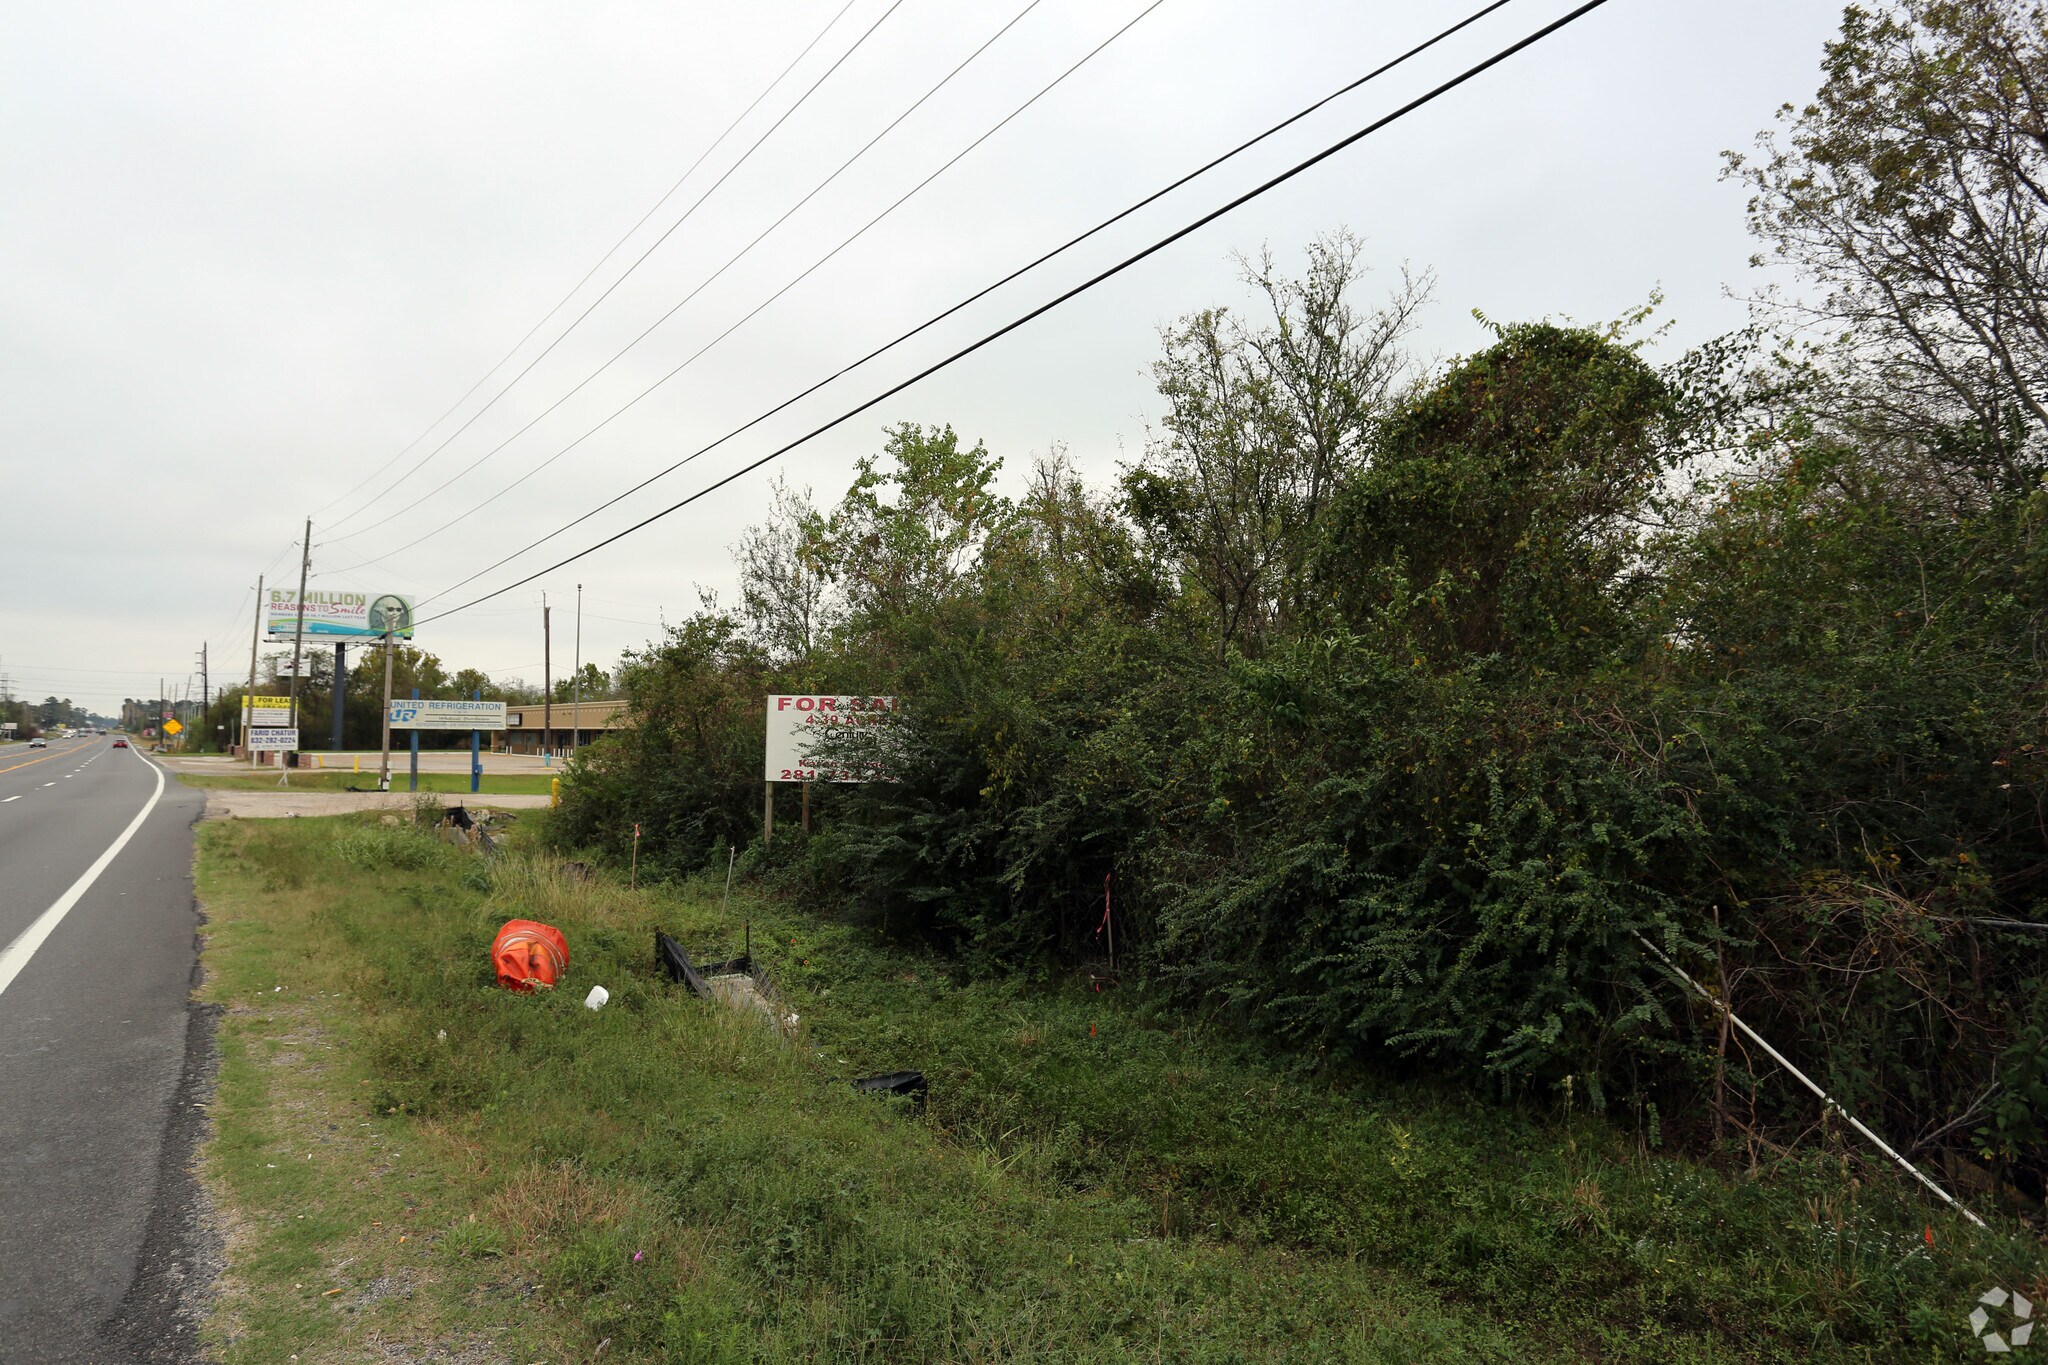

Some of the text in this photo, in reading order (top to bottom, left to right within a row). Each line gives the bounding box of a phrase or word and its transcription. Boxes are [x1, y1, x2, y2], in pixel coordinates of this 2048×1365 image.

[271, 590, 366, 607] 6.7 MILLION
[317, 604, 329, 613] TO
[328, 602, 366, 615] Smile
[390, 701, 501, 711] UNITED REFRIGERATION
[778, 697, 837, 712] FOR
